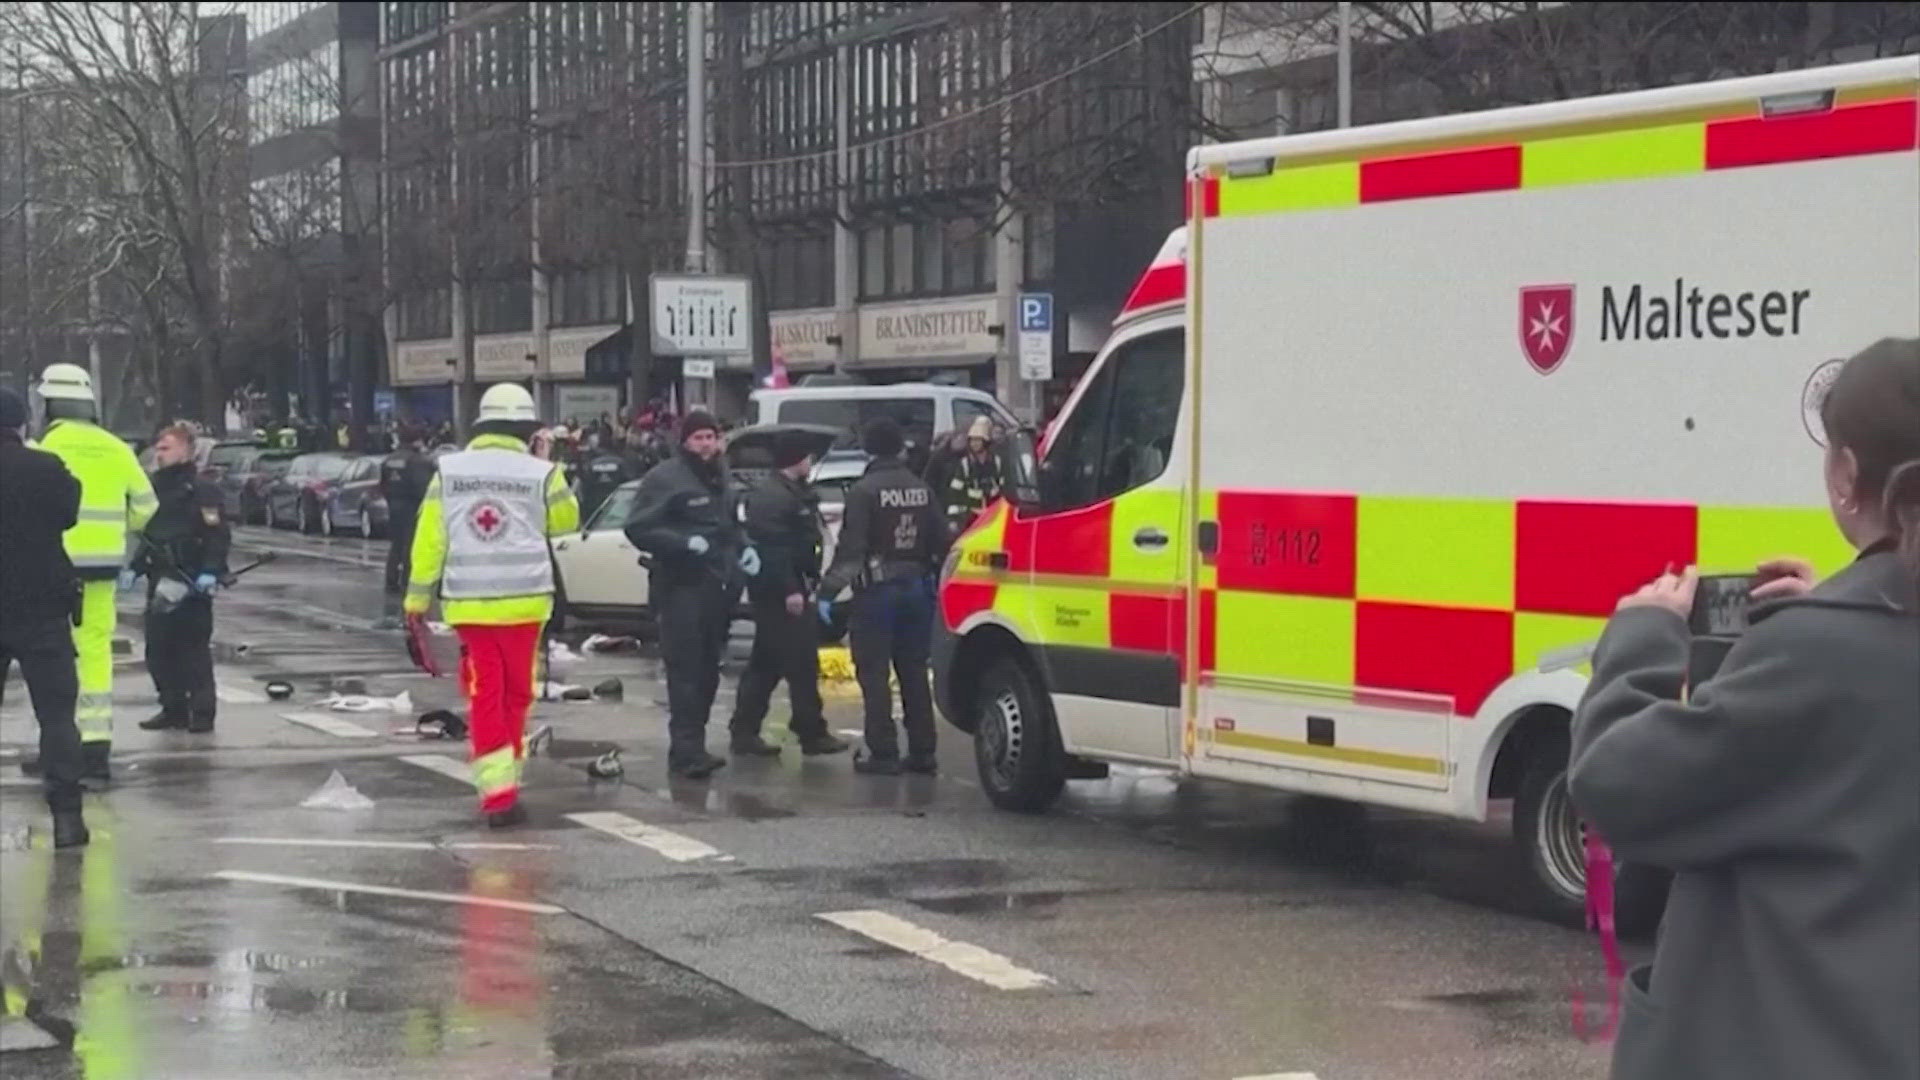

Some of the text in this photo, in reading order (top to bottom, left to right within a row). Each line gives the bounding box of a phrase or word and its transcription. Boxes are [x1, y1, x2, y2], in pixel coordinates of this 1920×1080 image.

[875, 308, 988, 341] BRANDSTETTER
[1023, 298, 1042, 328] P
[1600, 277, 1811, 342] Malteser
[880, 488, 929, 508] POLIZEI
[1277, 527, 1321, 566] 112
